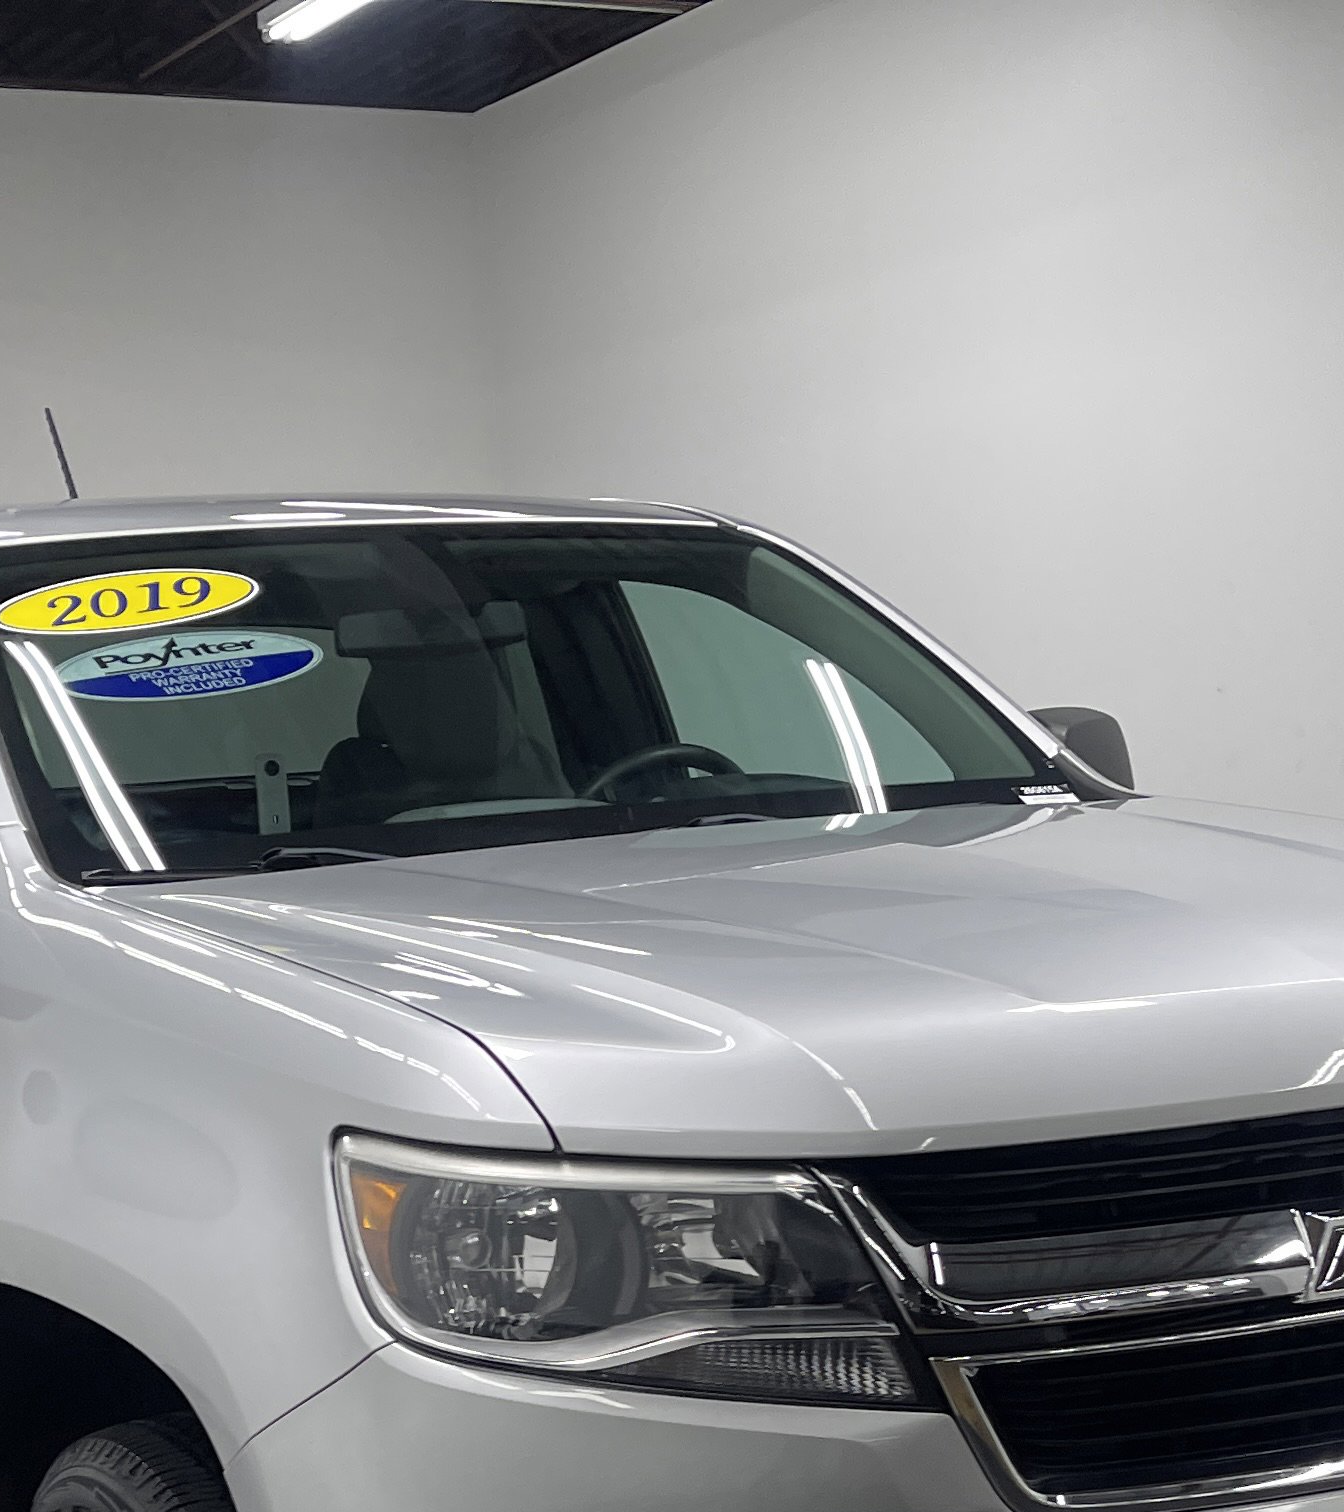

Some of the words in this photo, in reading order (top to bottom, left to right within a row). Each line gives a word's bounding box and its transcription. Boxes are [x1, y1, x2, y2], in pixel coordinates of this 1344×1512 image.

[47, 576, 212, 627] 2019
[93, 638, 256, 674] Poynter
[129, 658, 254, 683] PRO-CERTIFIED
[152, 668, 242, 688] WARRANTY
[163, 677, 247, 695] INCLUDED
